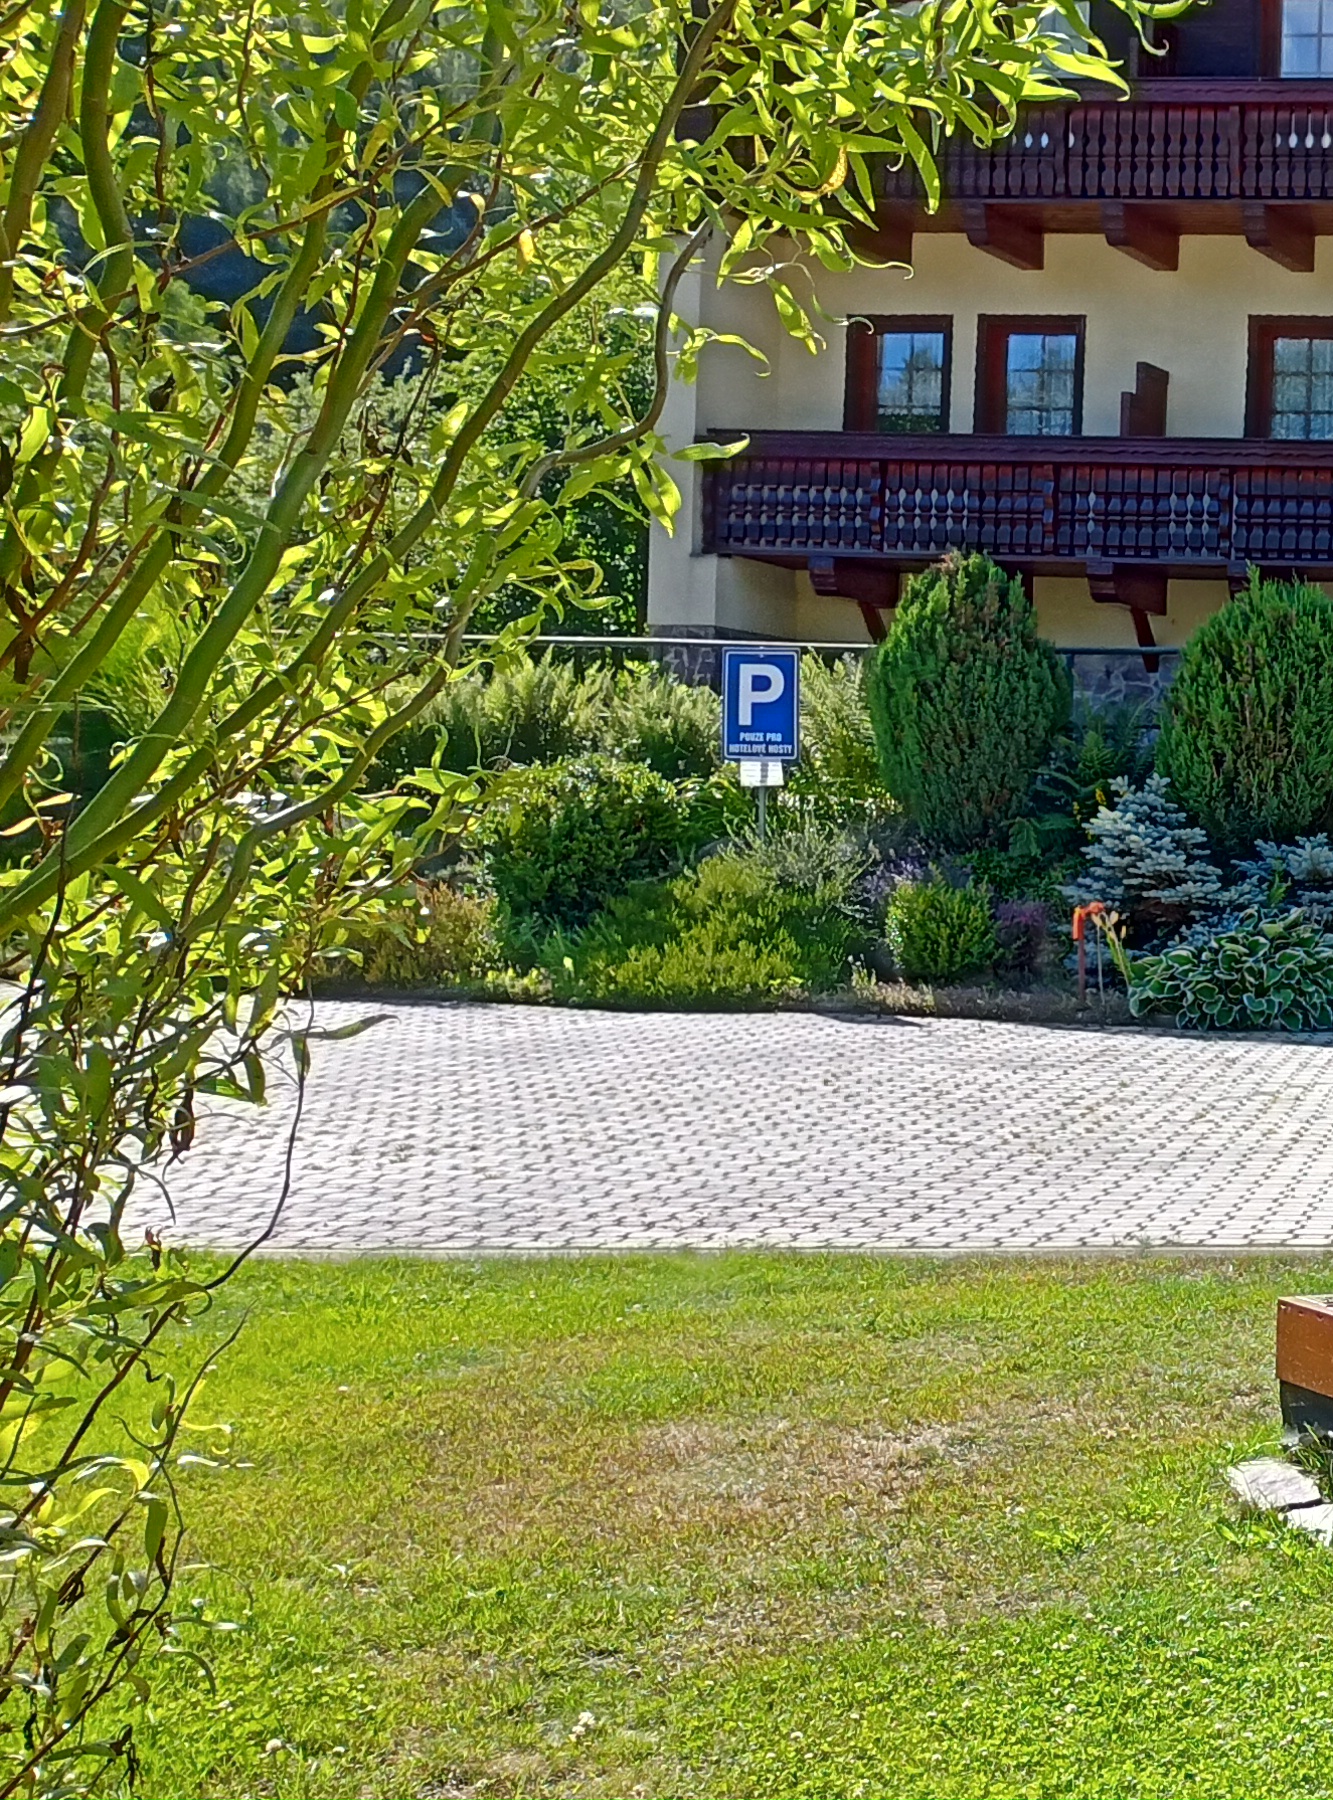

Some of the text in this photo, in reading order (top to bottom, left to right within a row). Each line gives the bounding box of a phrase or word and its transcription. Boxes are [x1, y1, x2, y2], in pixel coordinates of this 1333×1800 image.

[738, 663, 785, 726] P
[739, 732, 782, 742] POUZE PRO
[729, 743, 792, 754] HOTELOVÉ HOSTY
